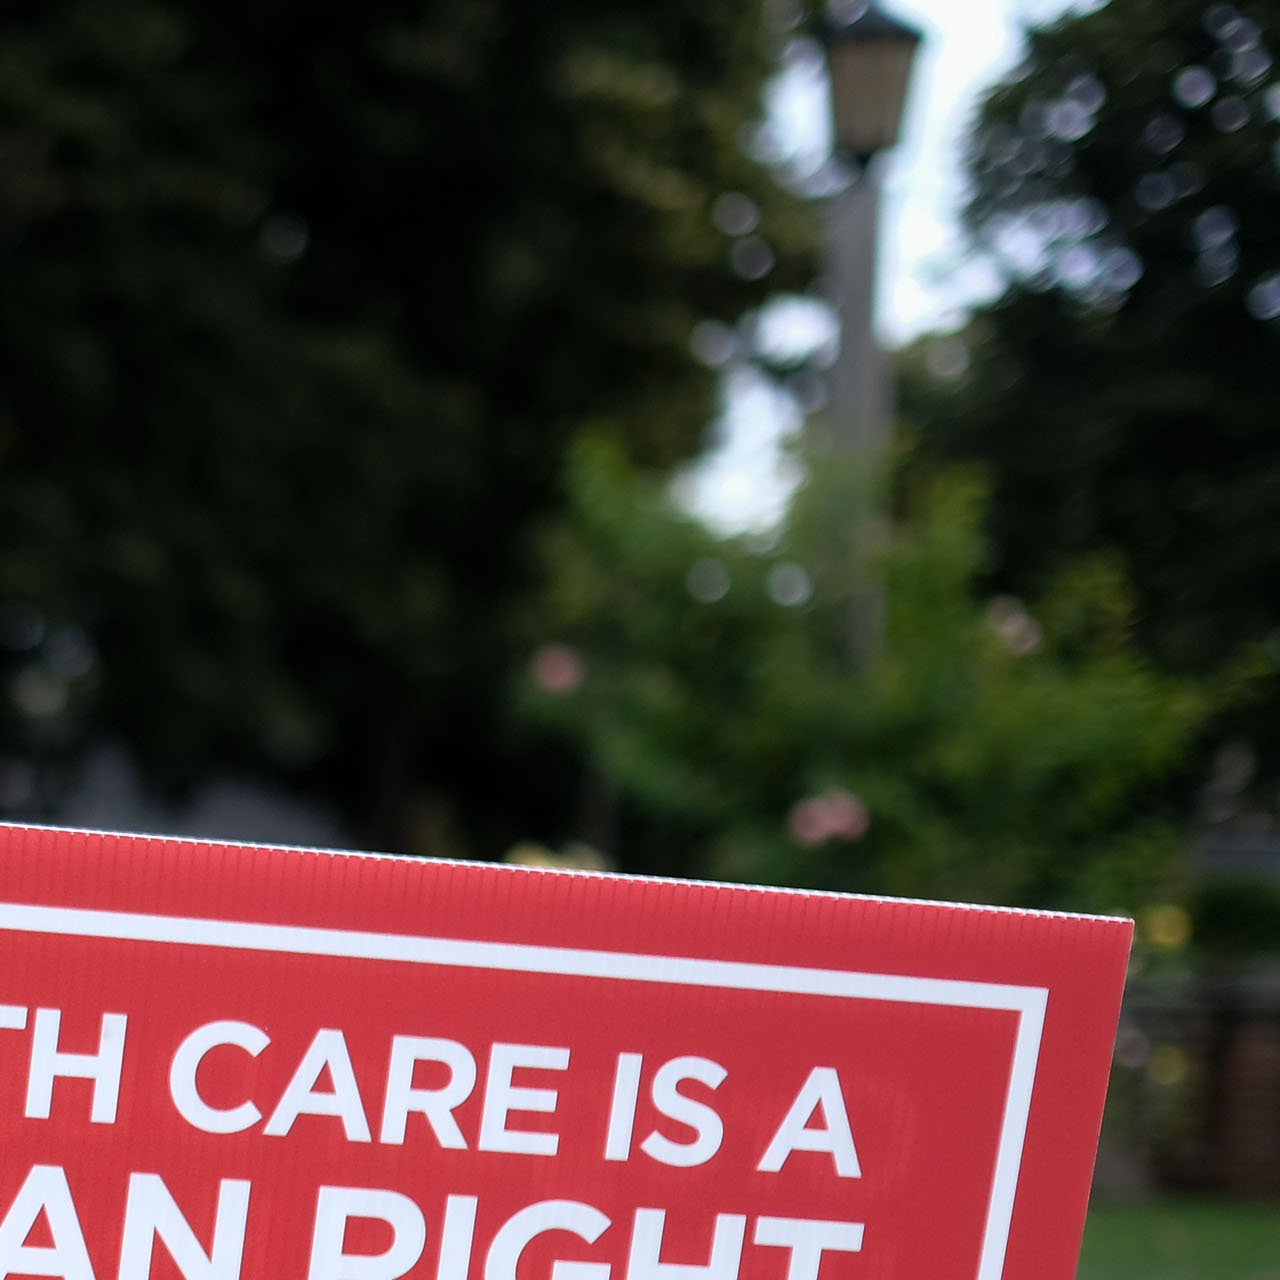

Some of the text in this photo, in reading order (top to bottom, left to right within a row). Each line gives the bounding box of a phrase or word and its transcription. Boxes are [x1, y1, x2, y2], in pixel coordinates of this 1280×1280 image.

[170, 1021, 570, 1155] CARE
[605, 1053, 727, 1166] IS
[757, 1067, 861, 1178] A
